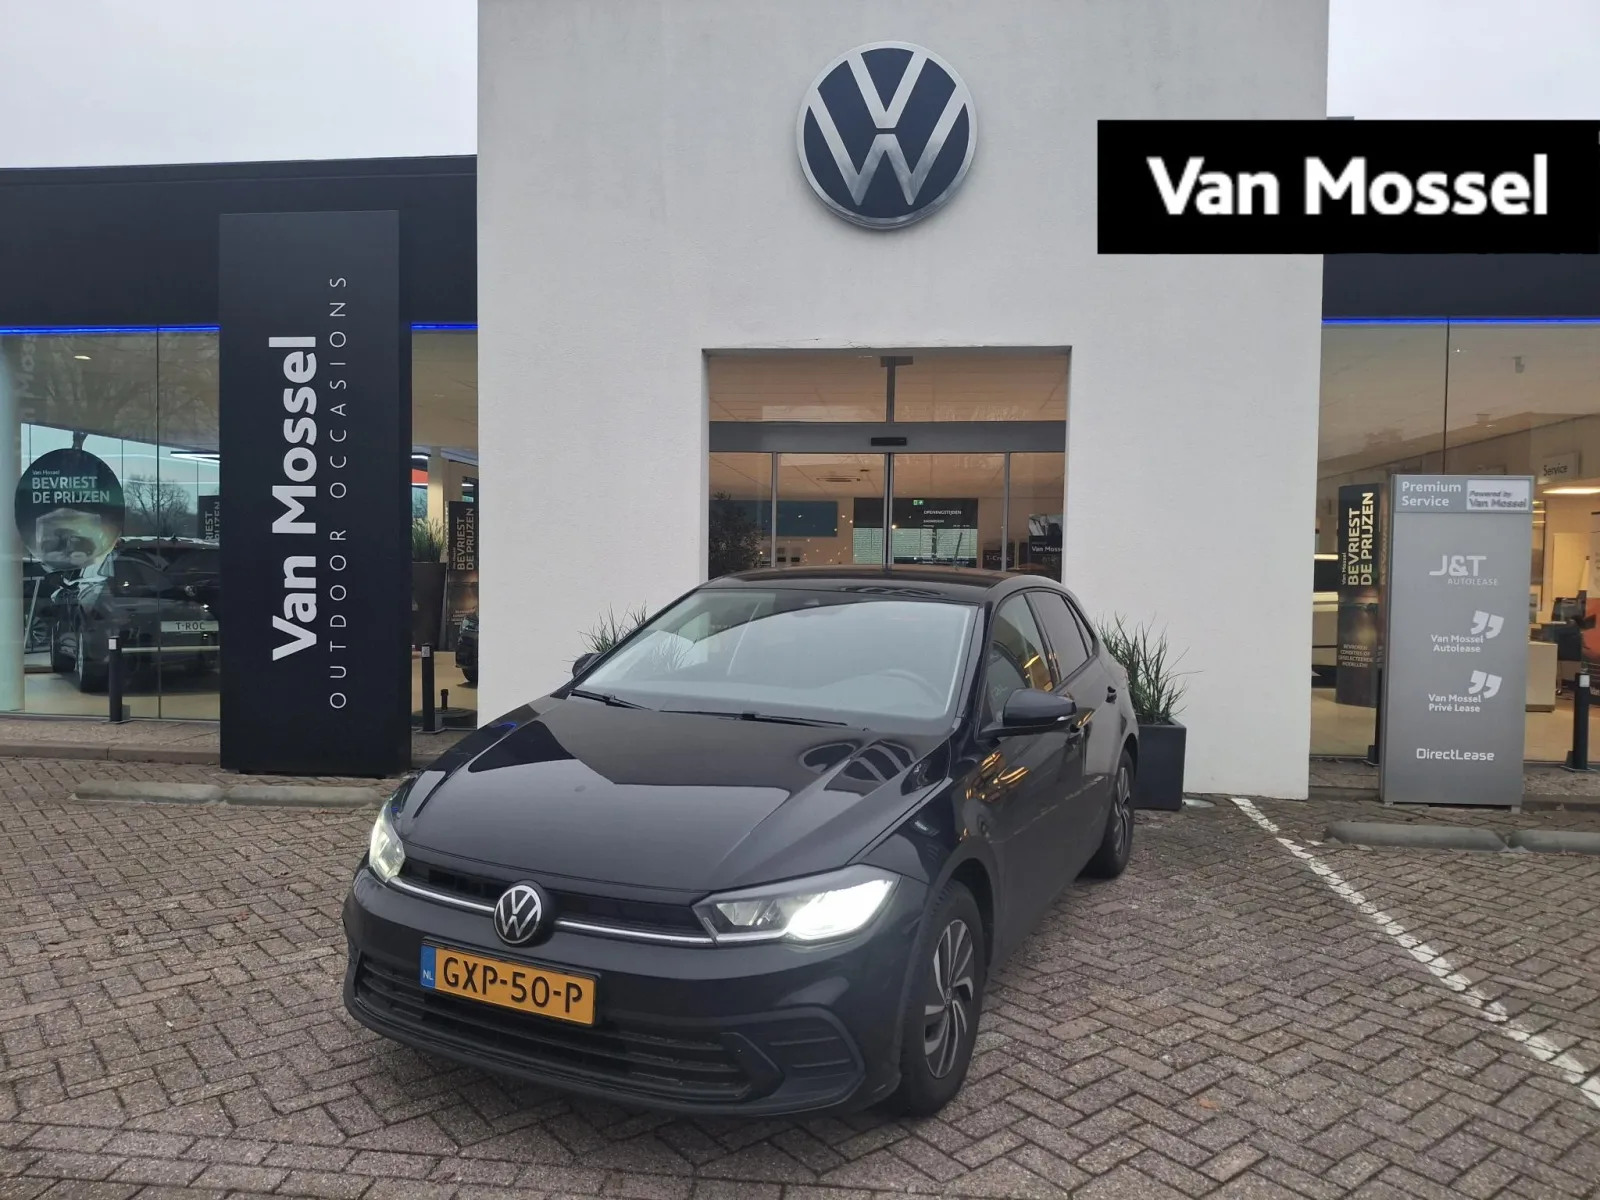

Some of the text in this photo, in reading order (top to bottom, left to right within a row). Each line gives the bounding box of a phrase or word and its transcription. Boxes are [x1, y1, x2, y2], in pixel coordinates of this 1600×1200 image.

[31, 476, 98, 489] BEVRIEST
[1402, 481, 1462, 492] Premium
[32, 490, 110, 504] DE PRIJZEN
[268, 336, 318, 661] Van Mossel
[329, 277, 347, 709] OUTDOOR OCCASIONS
[1503, 490, 1512, 498] by
[1402, 495, 1450, 507] Service
[1468, 498, 1527, 508] Van Mossel
[457, 518, 466, 570] BEVRIEST
[466, 508, 474, 570] DE PRIJZEN
[1360, 492, 1374, 586] DE PRIJZEN
[1347, 507, 1360, 586] BEVRIEST
[1428, 555, 1487, 576] J&T
[1447, 578, 1498, 586] AUTOLEASE
[176, 622, 205, 630] T-ROC
[1431, 634, 1484, 643] Van Mossel
[1433, 644, 1481, 653] Autolease
[1428, 694, 1482, 703] Van Mossel
[1428, 703, 1481, 713] Privé Lease
[1416, 747, 1495, 761] DirectLease
[422, 970, 434, 982] NL
[443, 956, 583, 1014] GXP-50-P
